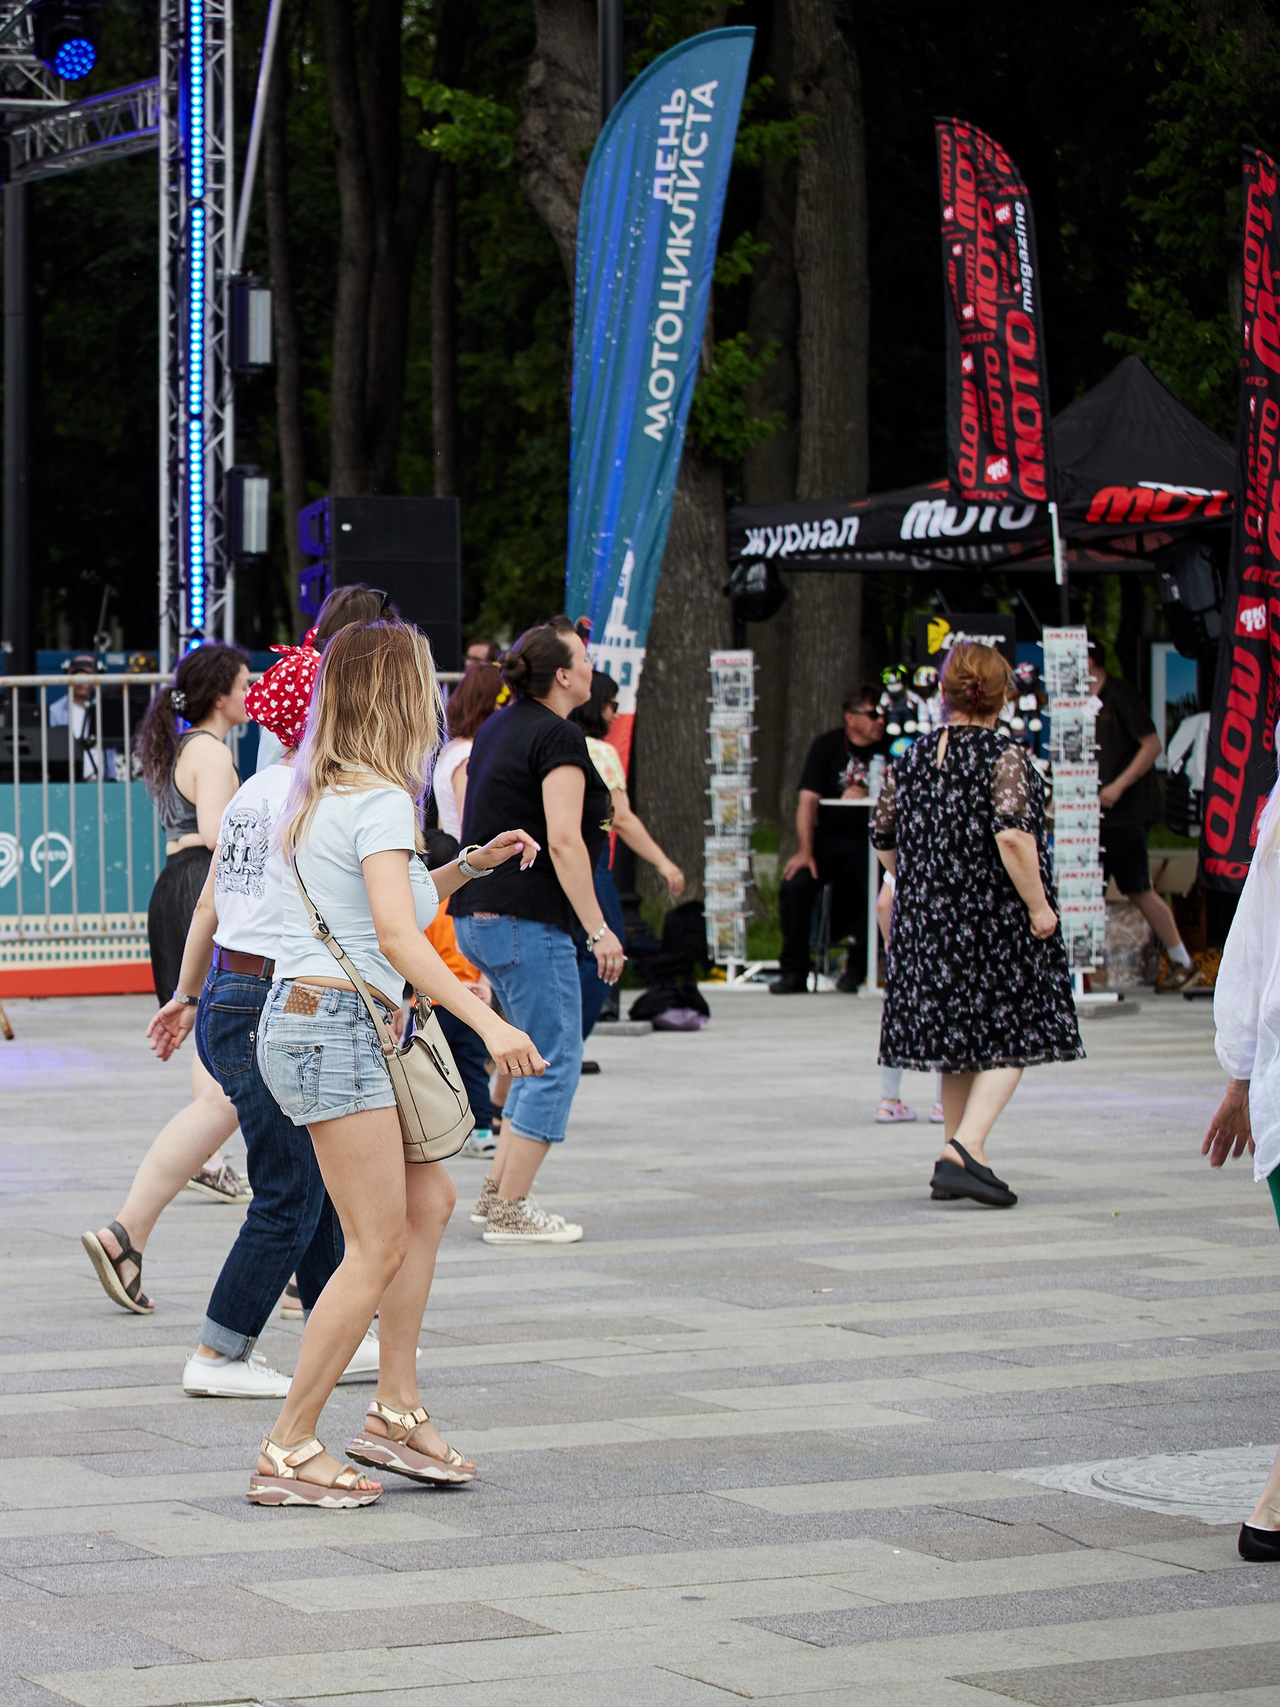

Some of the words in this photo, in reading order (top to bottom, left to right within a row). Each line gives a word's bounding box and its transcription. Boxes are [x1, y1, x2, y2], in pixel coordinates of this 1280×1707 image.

[653, 88, 686, 201] ДЕНЬ
[643, 79, 719, 442] МОТОЦИКЛИСТА
[1014, 201, 1034, 313] magazine
[741, 516, 860, 558] журнал
